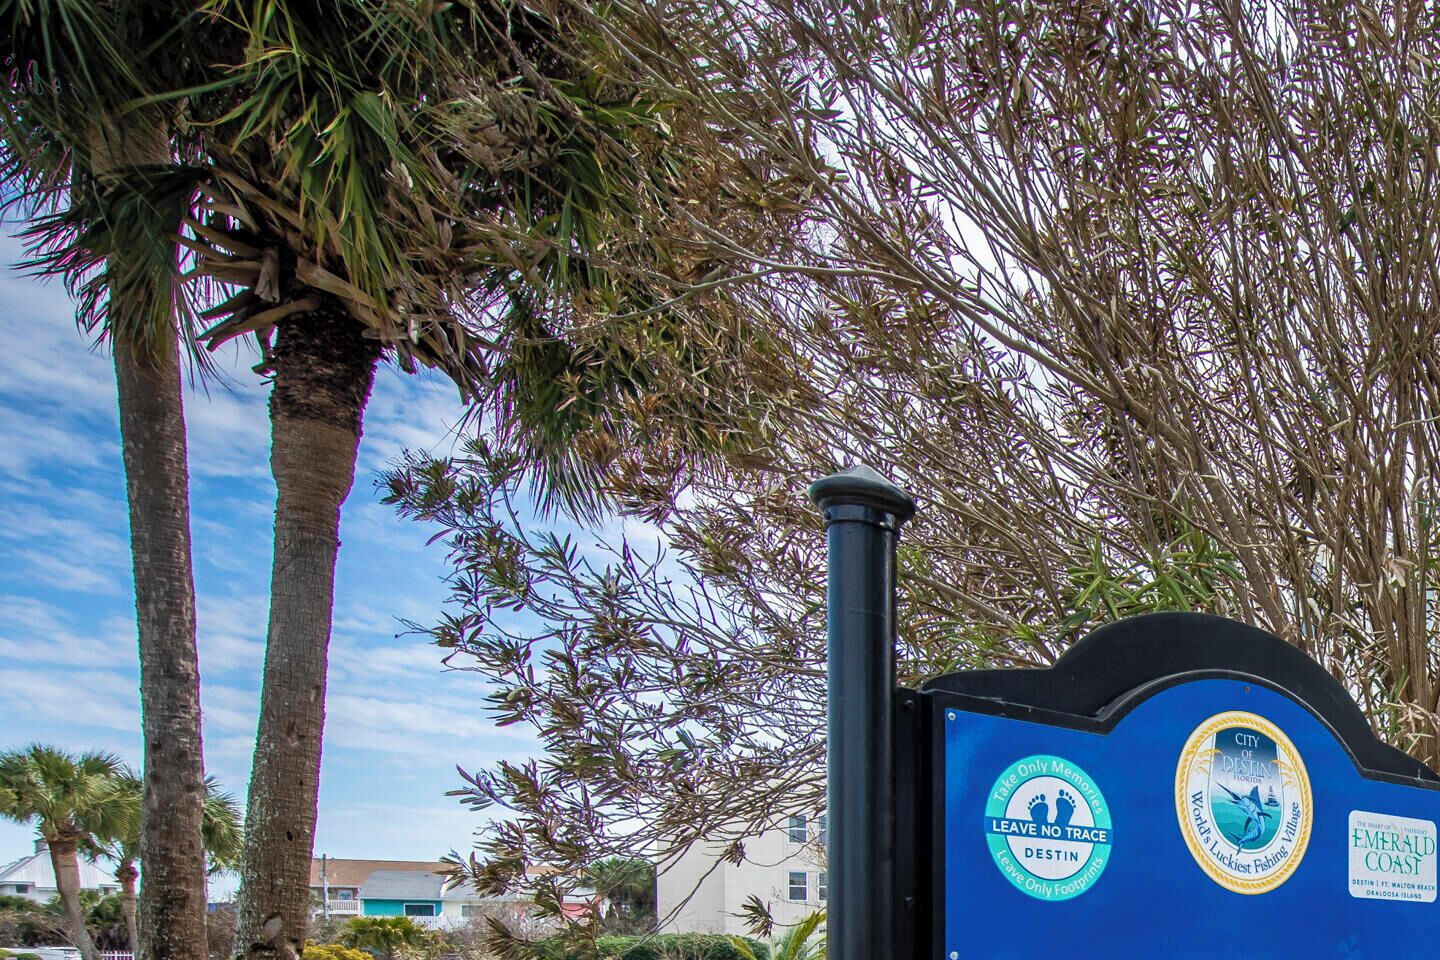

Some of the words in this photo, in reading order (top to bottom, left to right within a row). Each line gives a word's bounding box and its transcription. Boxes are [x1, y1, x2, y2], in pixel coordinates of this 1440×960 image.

[1234, 732, 1260, 748] CITY
[1242, 750, 1253, 760] OF
[1223, 756, 1271, 779] DESTIN
[994, 774, 1018, 802] Take
[1018, 759, 1048, 777] Only
[1052, 760, 1103, 815] Memories
[992, 819, 1037, 836] LEAVE
[1042, 825, 1062, 838] NO
[1066, 827, 1107, 842] TRACE
[1191, 790, 1212, 844] World's
[1209, 841, 1251, 874] Luckiest
[1254, 846, 1289, 874] Fishing
[1282, 802, 1301, 843] Village
[1352, 828, 1436, 857] EMERALD
[1024, 848, 1078, 862] DESTIN
[1365, 850, 1422, 875] COAST
[996, 850, 1025, 884] Leave
[1026, 878, 1051, 898] Only
[1054, 857, 1104, 896] Footprints
[1366, 890, 1399, 898] OKALOOSA
